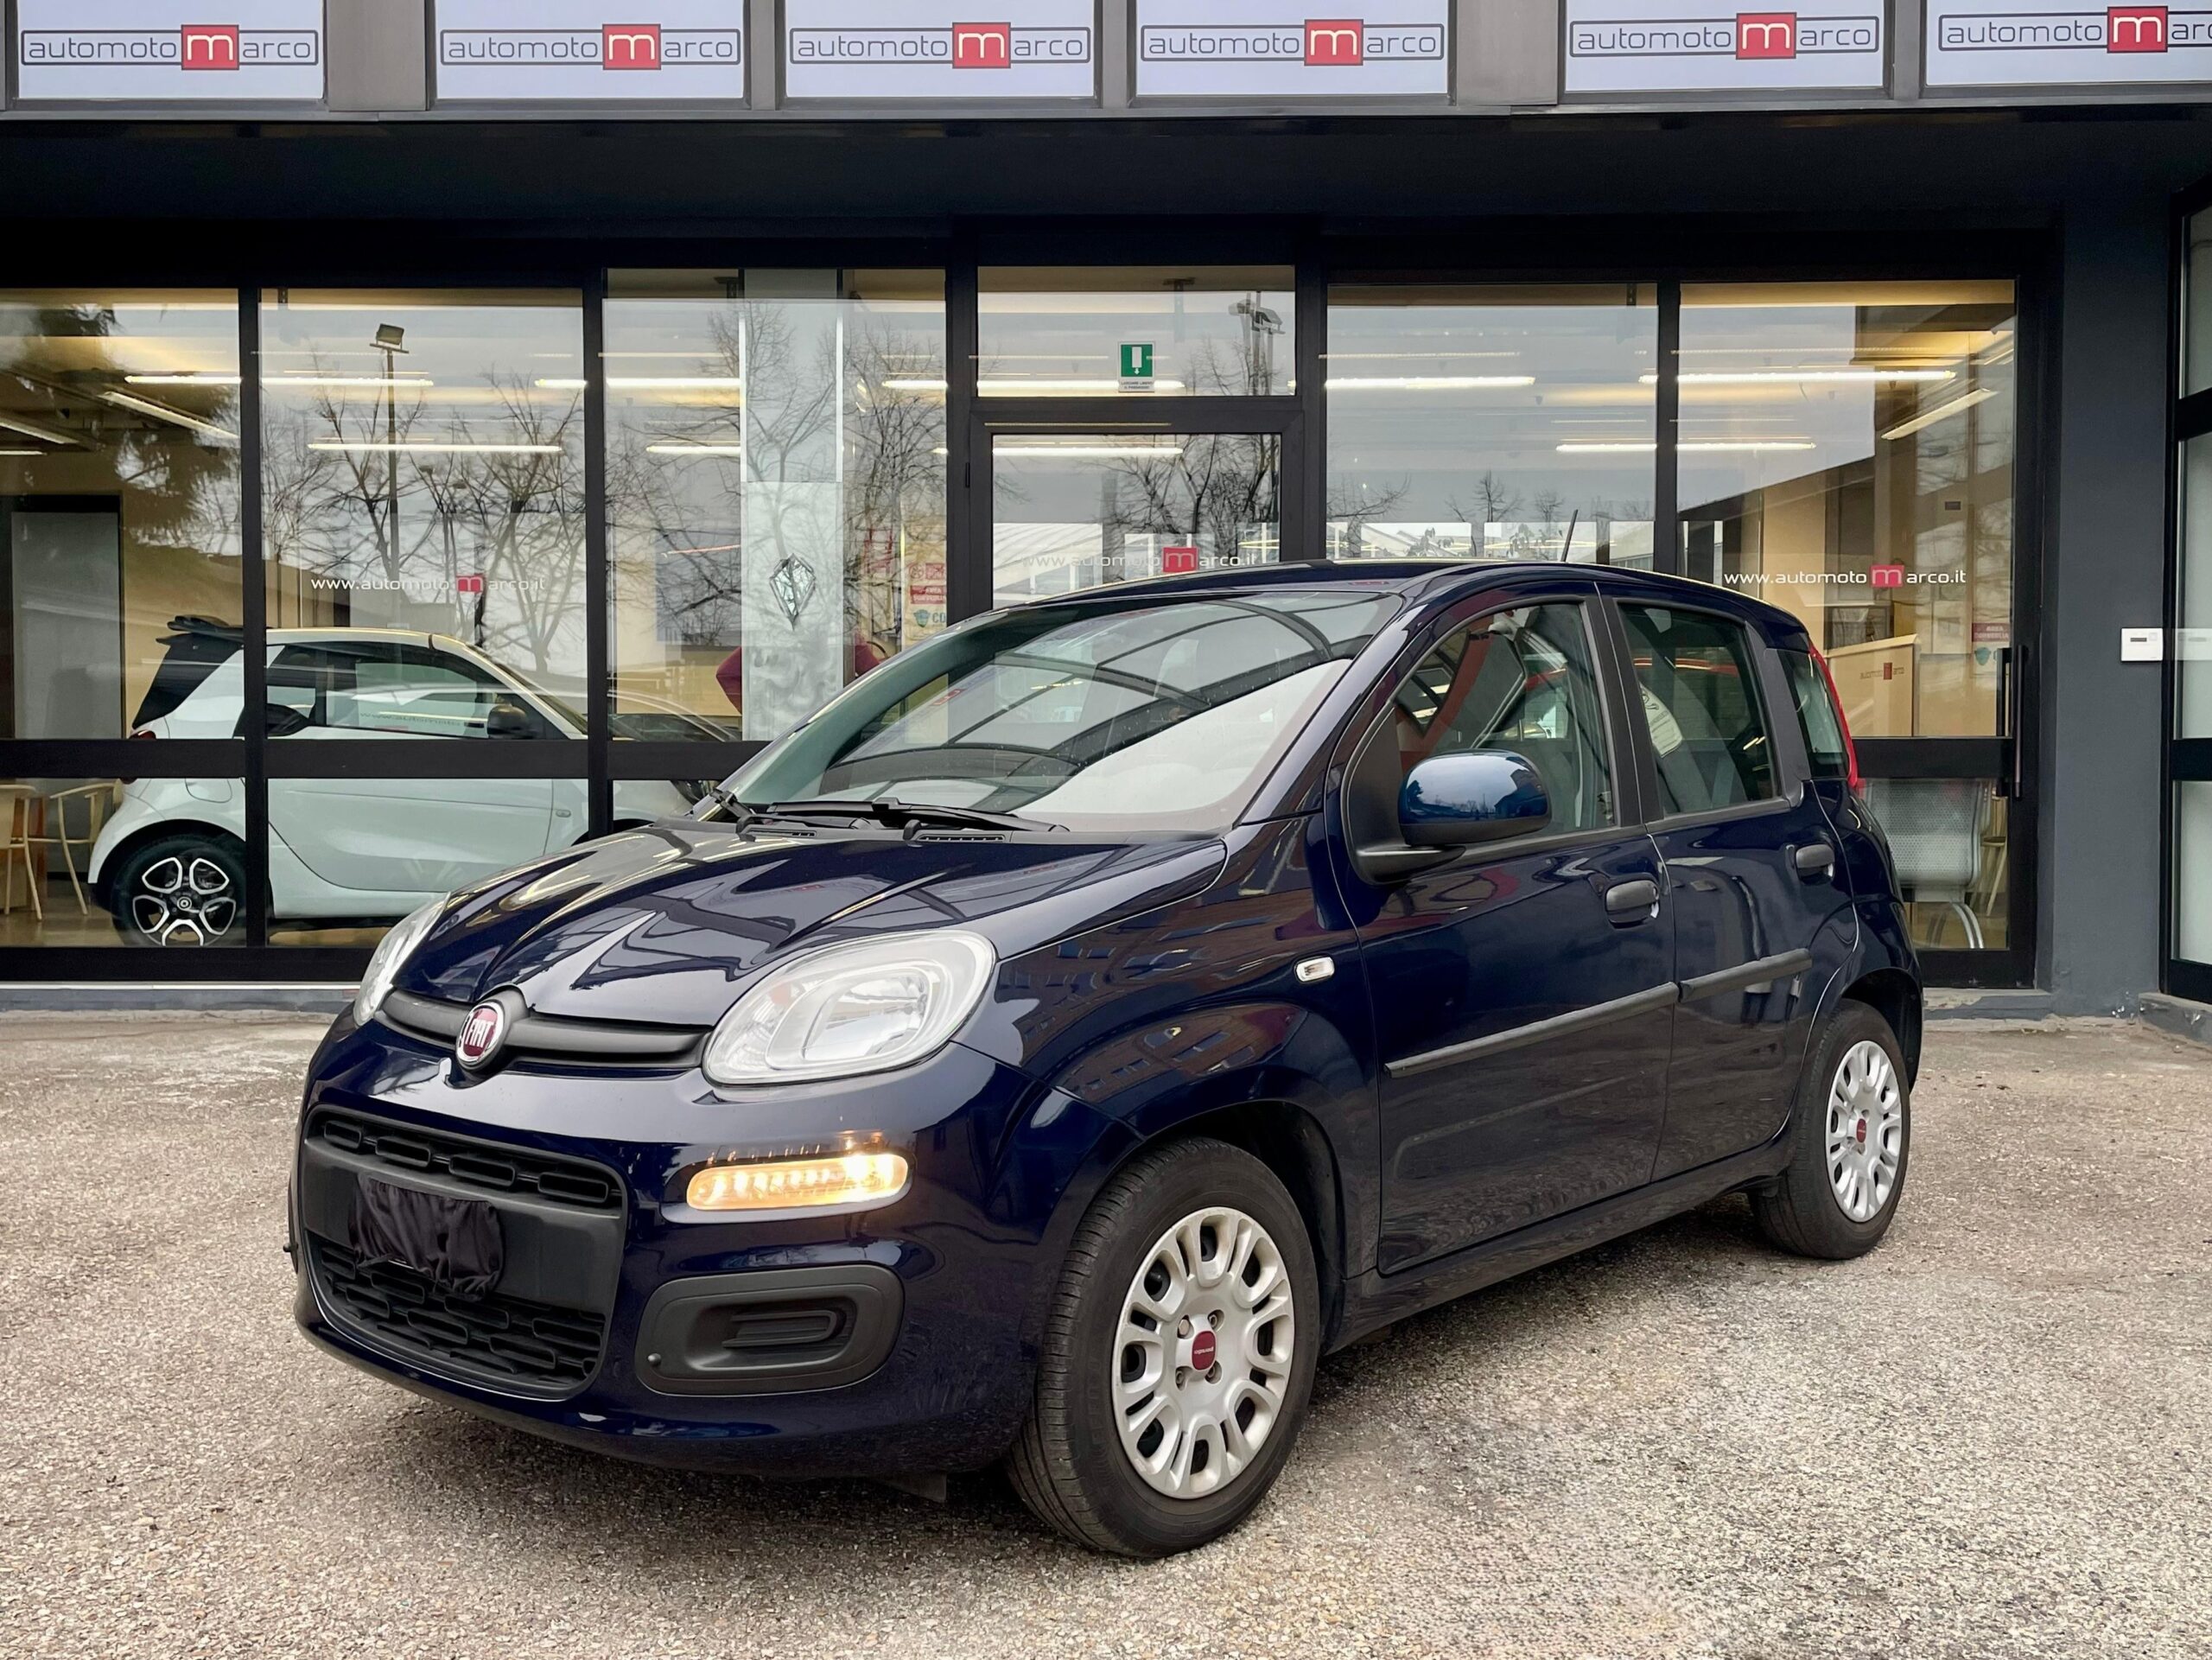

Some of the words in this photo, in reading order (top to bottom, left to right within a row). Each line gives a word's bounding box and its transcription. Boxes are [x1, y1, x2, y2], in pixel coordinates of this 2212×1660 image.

[1578, 26, 1732, 50] automoto
[1947, 20, 2102, 44] automoto
[2113, 16, 2212, 43] mar
[29, 37, 176, 59] automoto
[448, 37, 598, 58] automoto
[798, 35, 948, 57] automoto
[1149, 32, 1300, 54] automoto
[1724, 569, 1967, 585] www.automotomarco.it
[464, 1018, 494, 1048] FIAT
